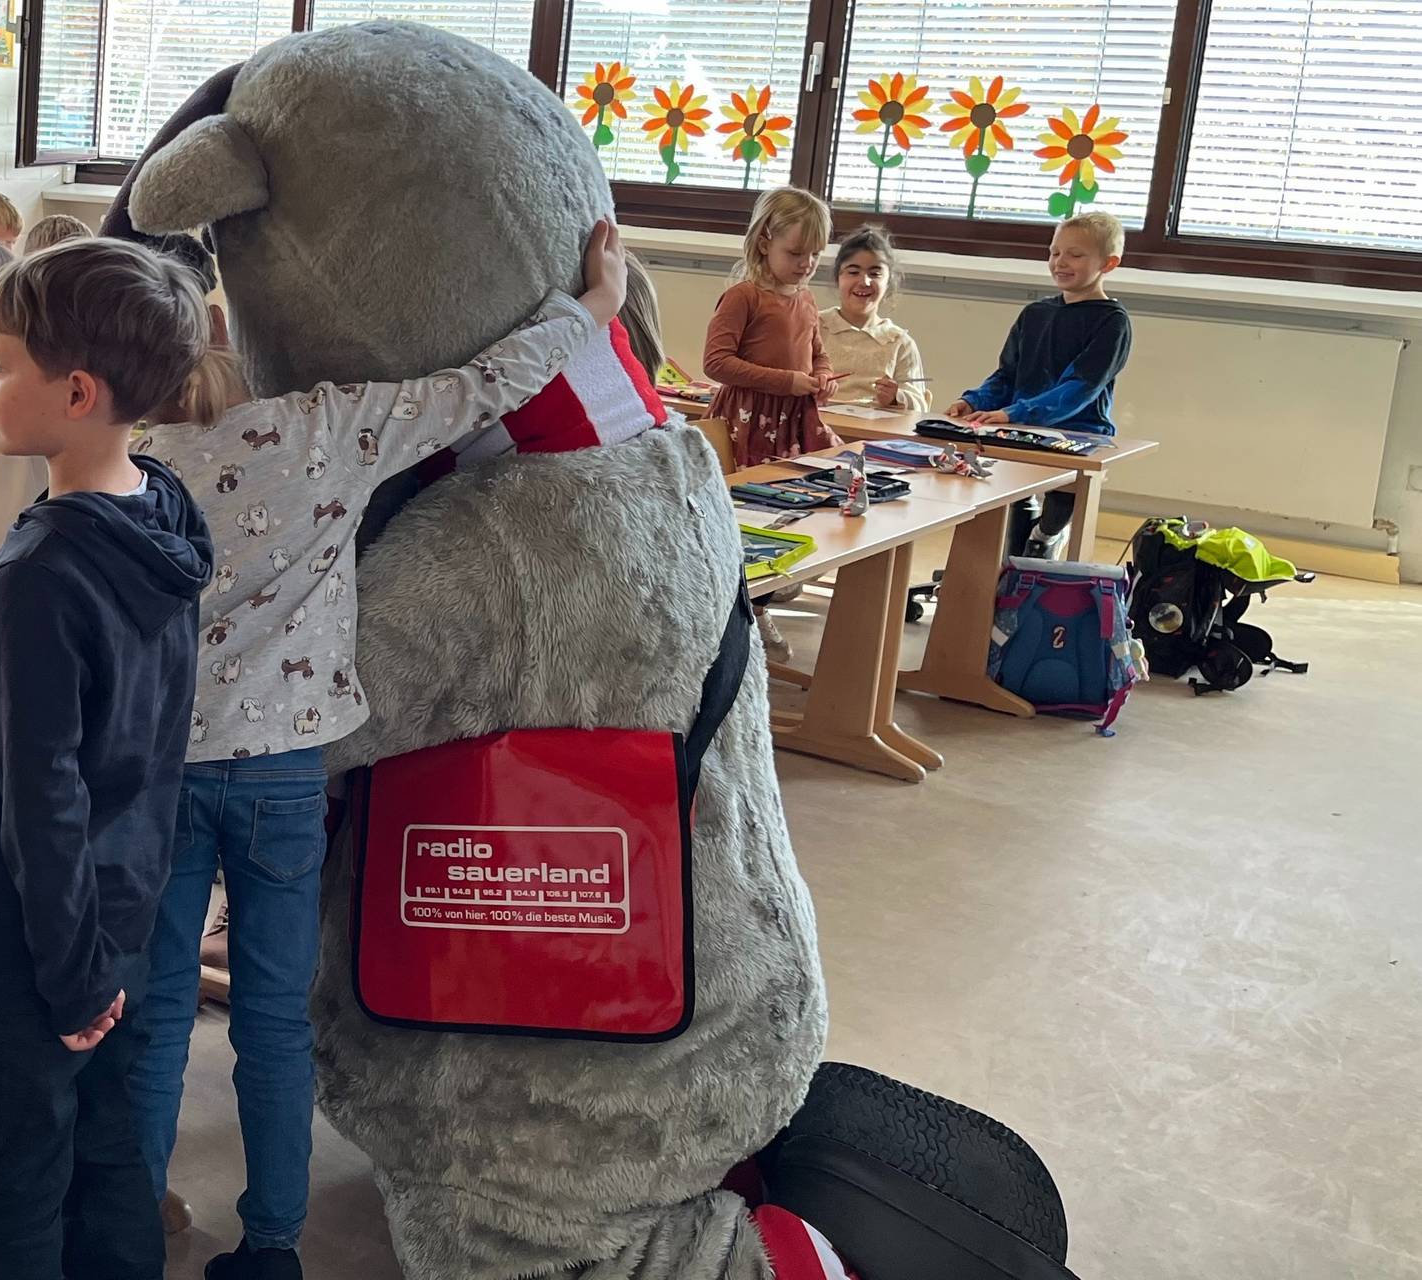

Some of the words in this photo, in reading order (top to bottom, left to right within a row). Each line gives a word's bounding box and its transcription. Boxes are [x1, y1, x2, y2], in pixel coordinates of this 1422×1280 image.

[417, 838, 493, 859] radio
[447, 862, 610, 884] sauerland
[412, 907, 442, 918] 100%
[445, 910, 463, 919] von
[465, 909, 488, 920] hier.
[489, 910, 523, 921] 100%
[525, 911, 542, 922] die
[544, 912, 576, 923] beste
[578, 912, 616, 924] Musik.
